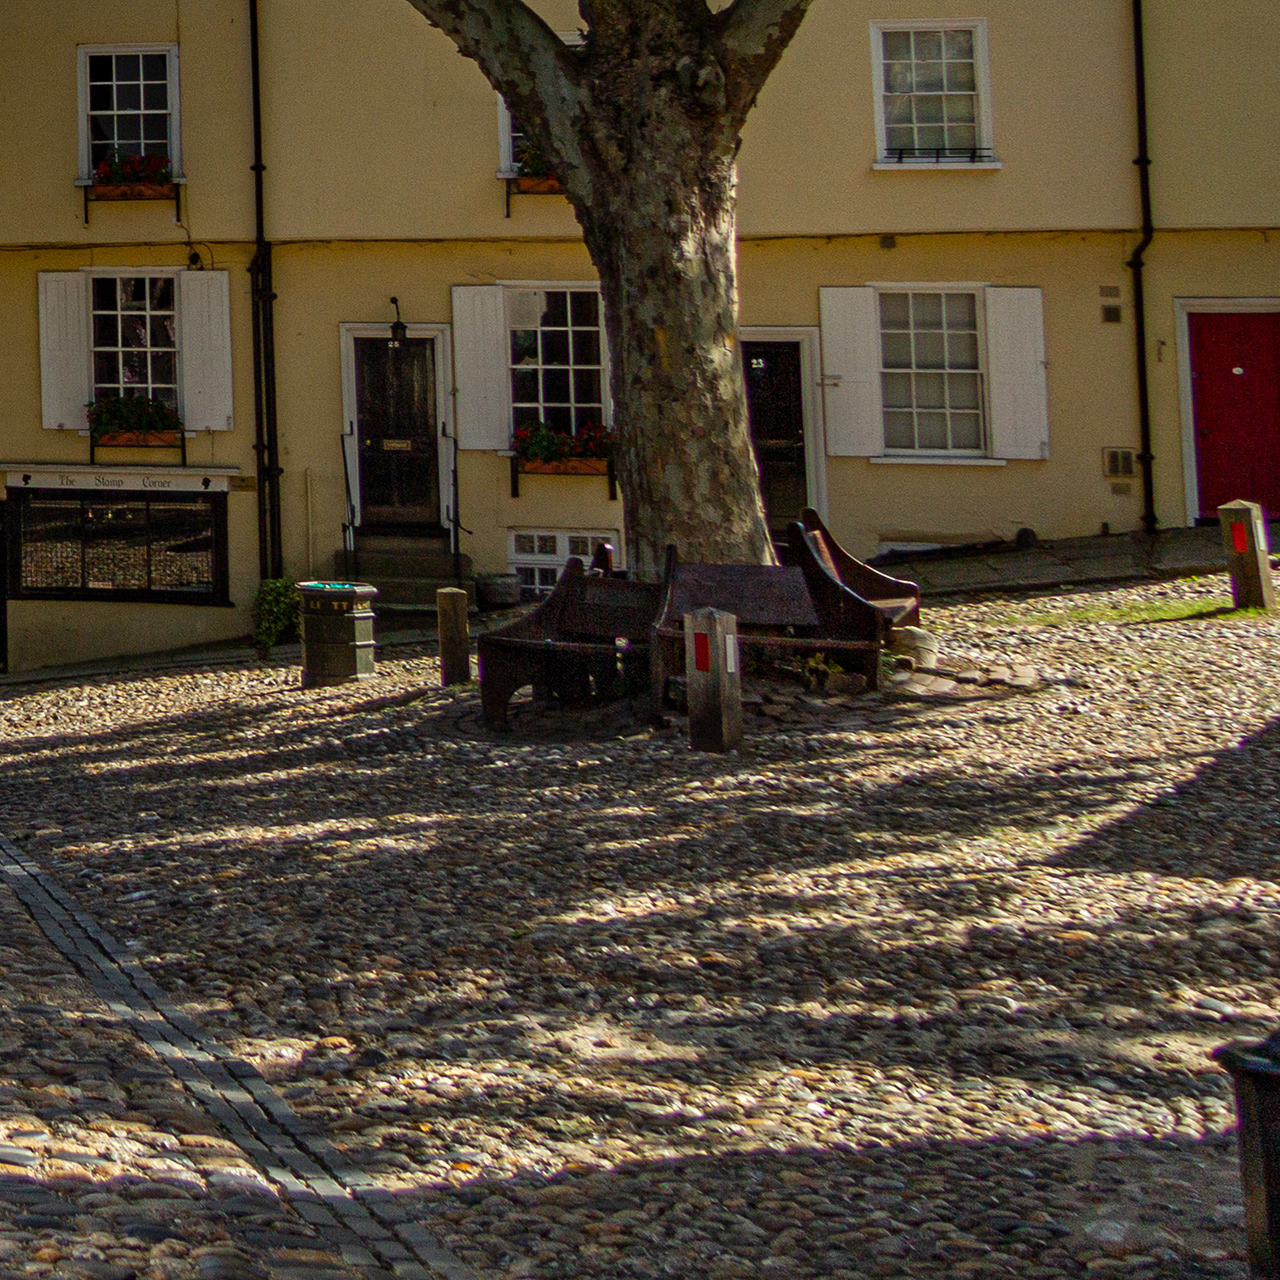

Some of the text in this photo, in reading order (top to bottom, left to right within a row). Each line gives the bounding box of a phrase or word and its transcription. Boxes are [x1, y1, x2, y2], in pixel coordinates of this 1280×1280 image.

[751, 358, 765, 368] 23
[58, 475, 75, 487] The
[142, 477, 172, 489] Corner
